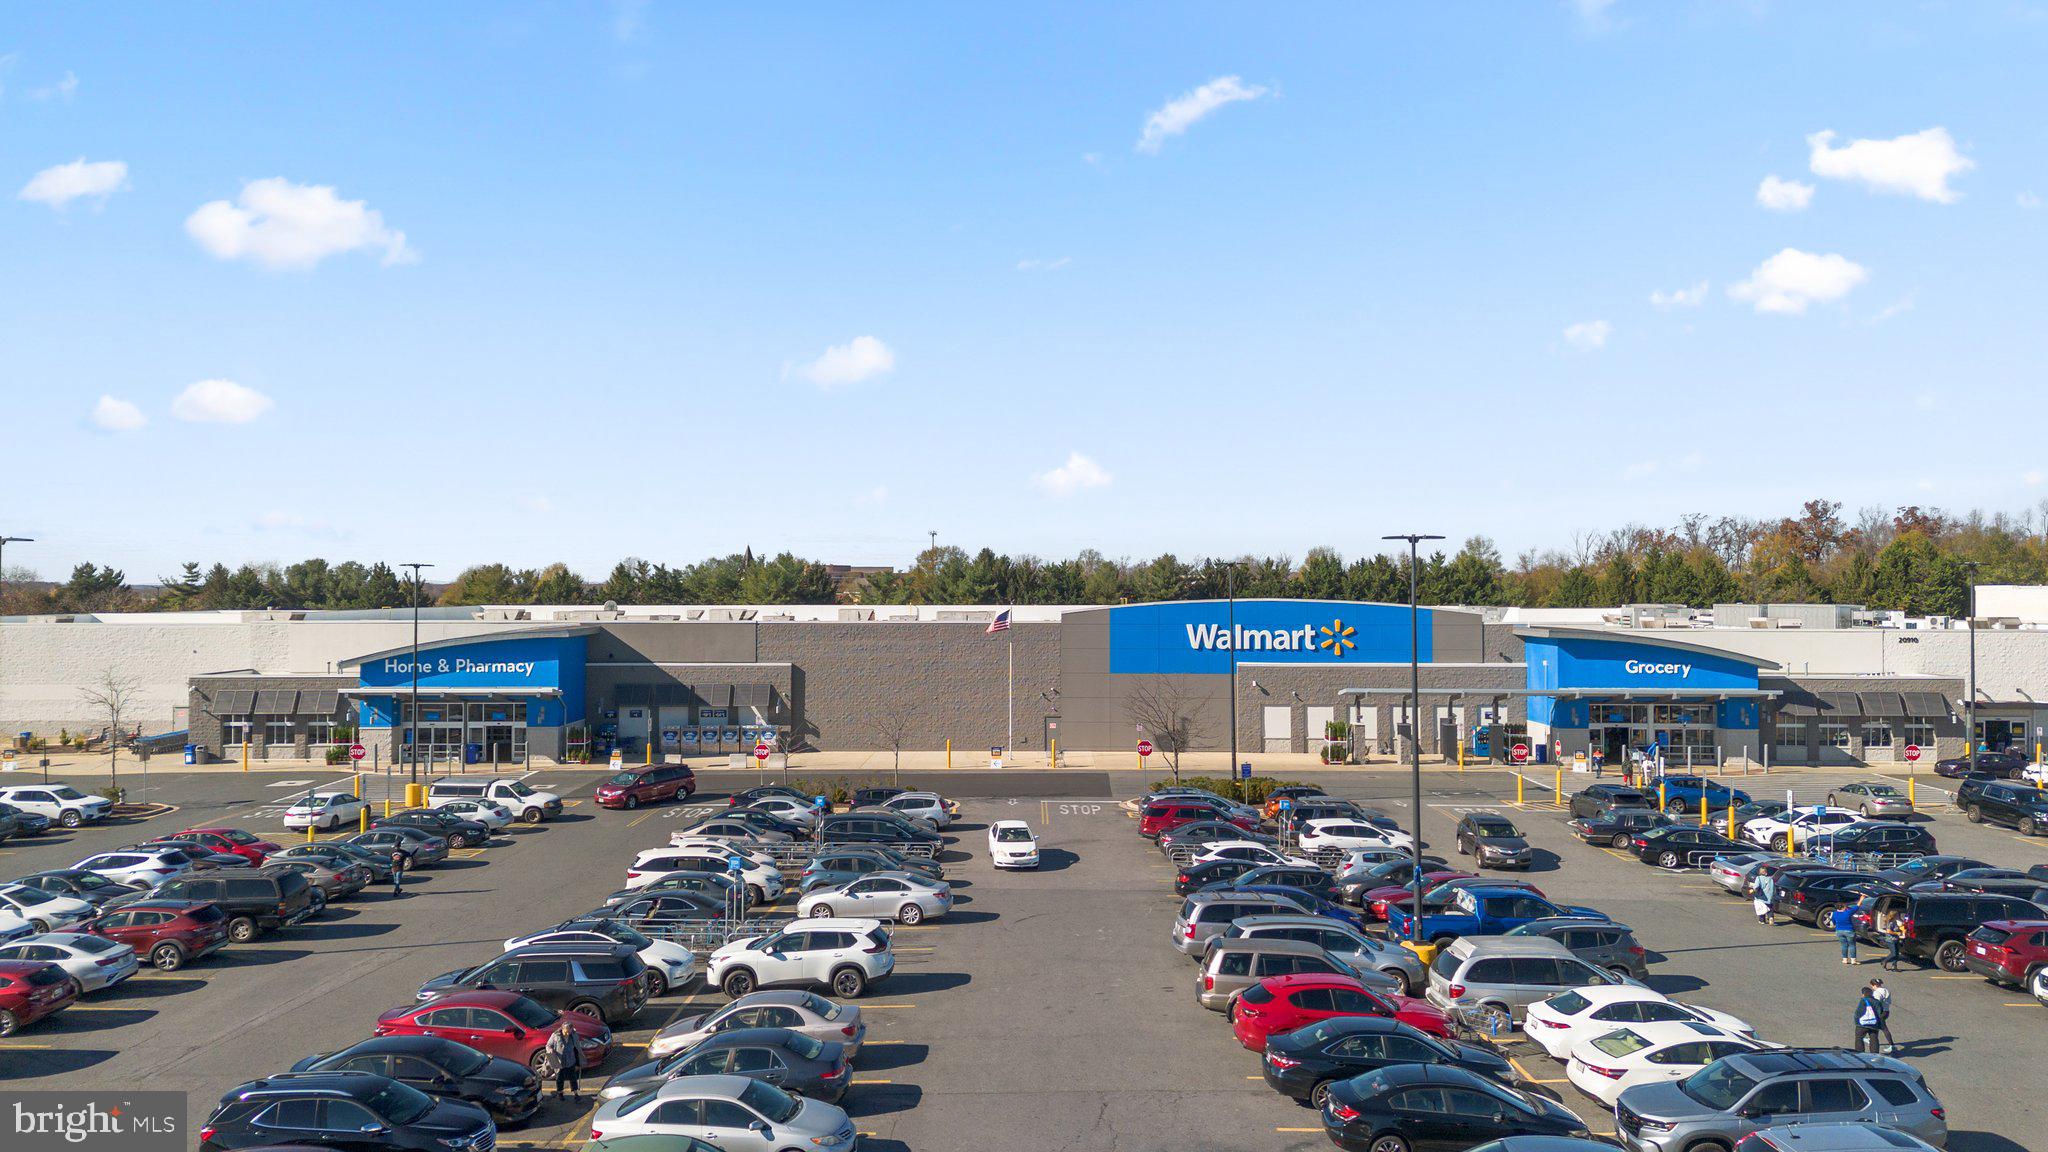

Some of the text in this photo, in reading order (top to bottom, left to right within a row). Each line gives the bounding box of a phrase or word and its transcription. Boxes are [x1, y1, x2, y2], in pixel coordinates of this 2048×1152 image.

[1186, 624, 1316, 650] Walmart
[385, 658, 535, 677] Home & Pharmacy
[1625, 660, 1692, 679] Grocery
[350, 748, 365, 756] STOP
[755, 748, 769, 756] STOP
[1905, 749, 1920, 757] STOP
[662, 807, 714, 818] STOP
[1060, 804, 1101, 815] STOP
